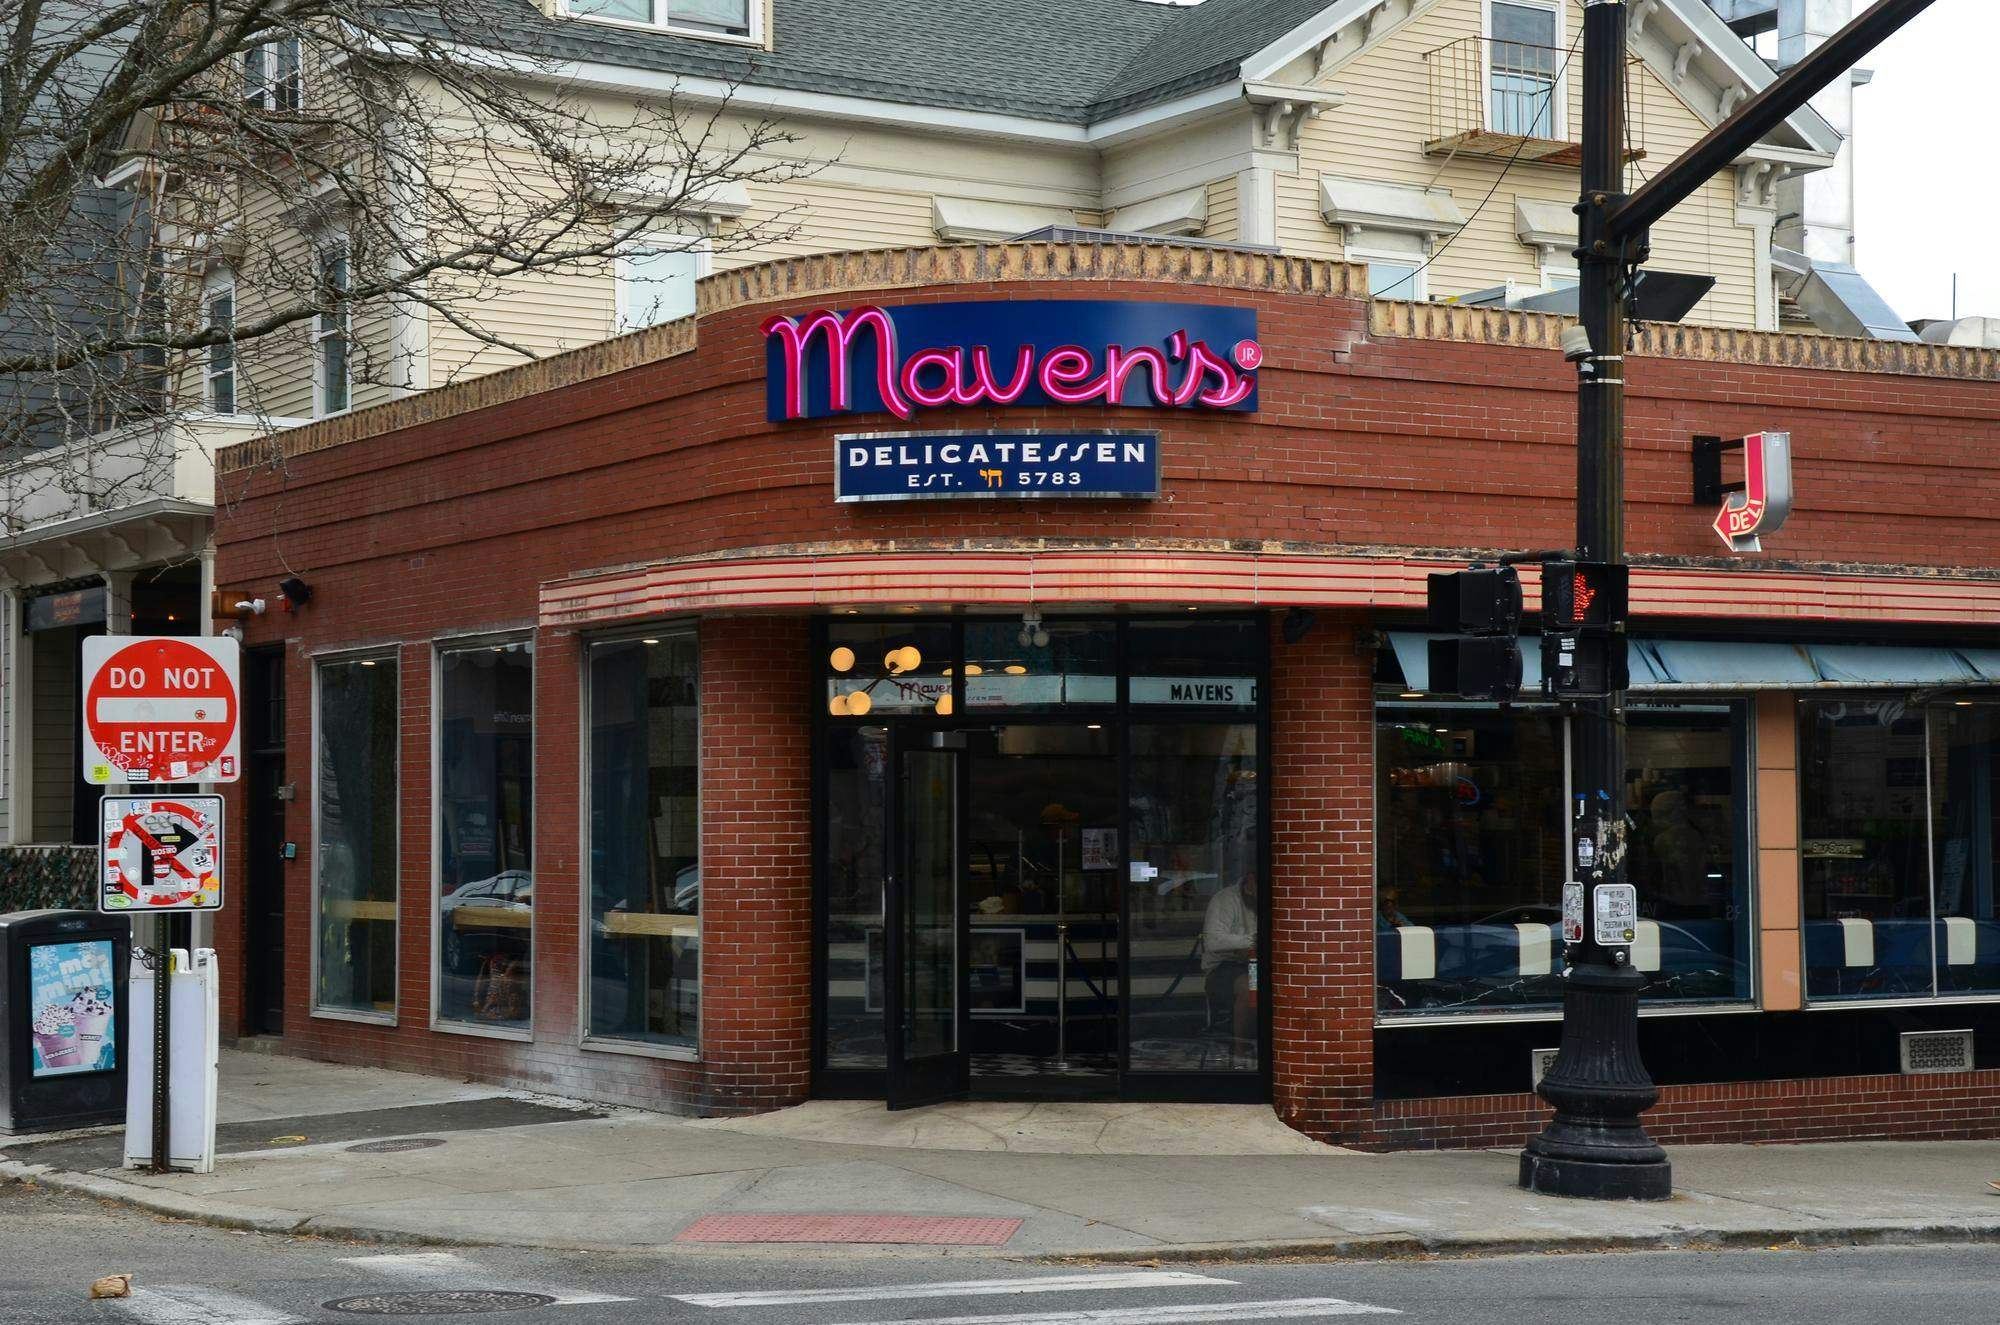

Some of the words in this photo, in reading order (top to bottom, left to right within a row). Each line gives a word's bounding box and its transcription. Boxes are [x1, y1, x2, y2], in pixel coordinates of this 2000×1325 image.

[760, 305, 1256, 421] Maven's
[1241, 347, 1257, 362] JR
[849, 443, 1146, 467] DELICATESSEN
[908, 474, 963, 487] EST.
[979, 469, 1003, 488] חי
[1019, 472, 1081, 485] 5783
[1729, 499, 1763, 531] DELI
[110, 667, 146, 689] DO
[164, 667, 215, 689] NOT
[1171, 684, 1234, 701] MAVENS
[120, 731, 204, 753] ENTER
